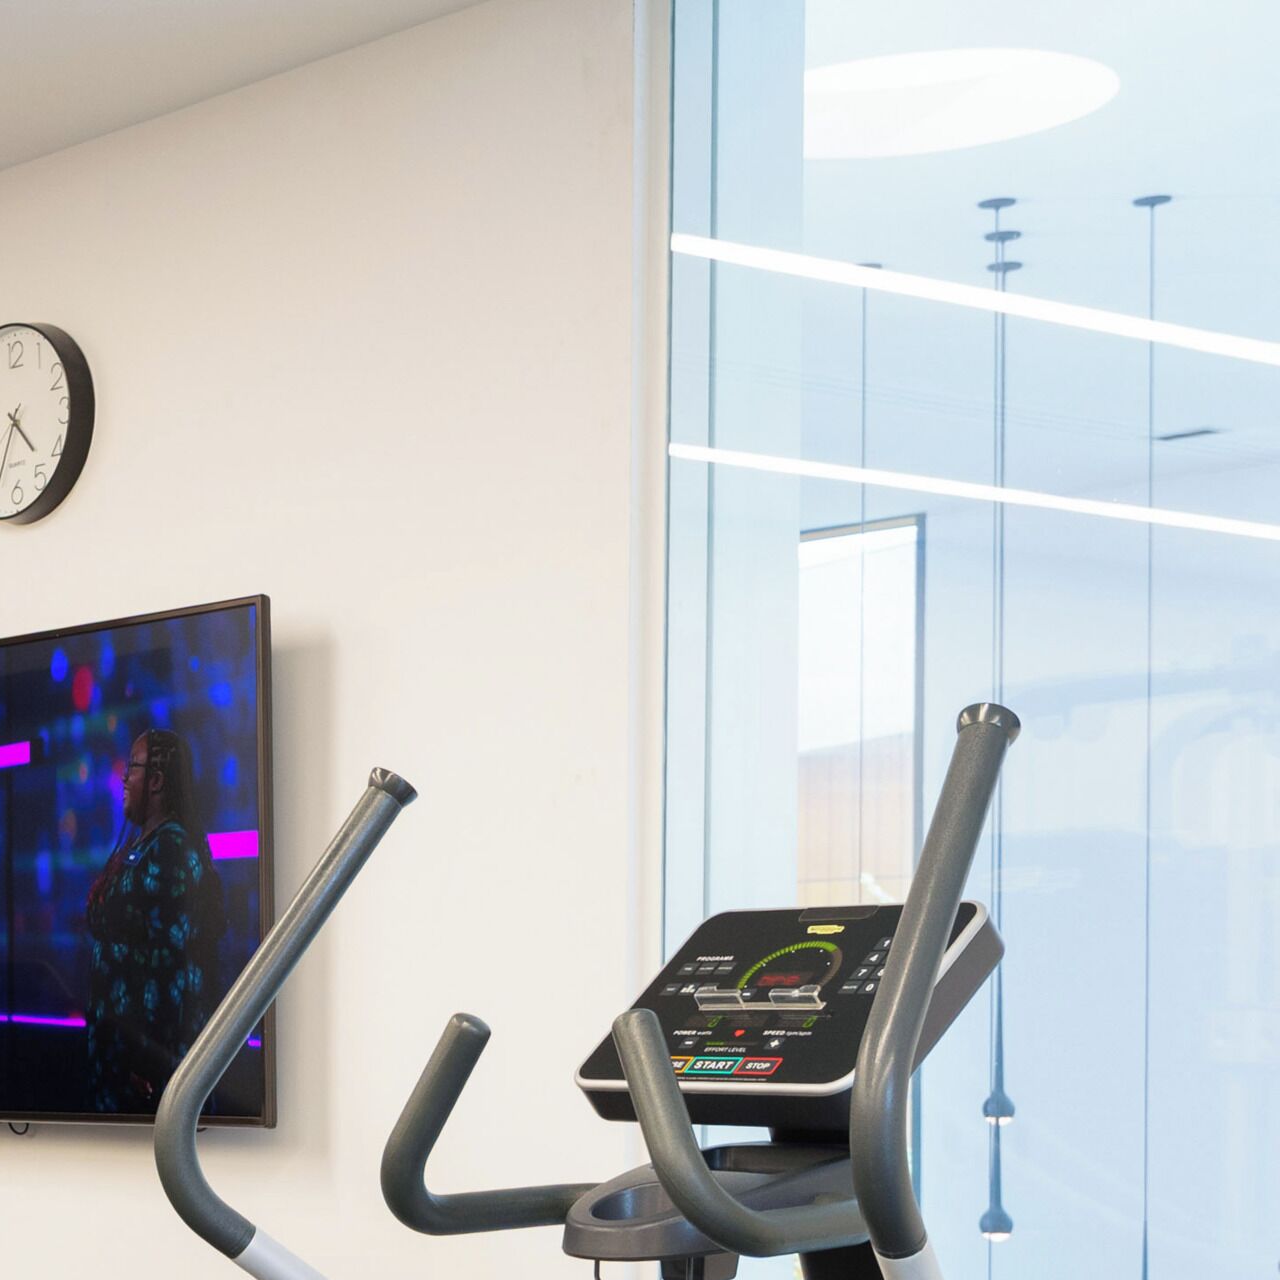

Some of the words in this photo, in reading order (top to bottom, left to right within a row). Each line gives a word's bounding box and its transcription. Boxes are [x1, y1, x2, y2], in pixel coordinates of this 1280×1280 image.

[7, 340, 25, 369] 12
[36, 342, 42, 369] 1
[50, 362, 64, 391] 2
[57, 396, 70, 425] 3
[51, 434, 64, 457] 4
[34, 463, 47, 492] 5
[11, 480, 24, 505] 6
[693, 1060, 735, 1070] START
[745, 1062, 772, 1070] STOP
